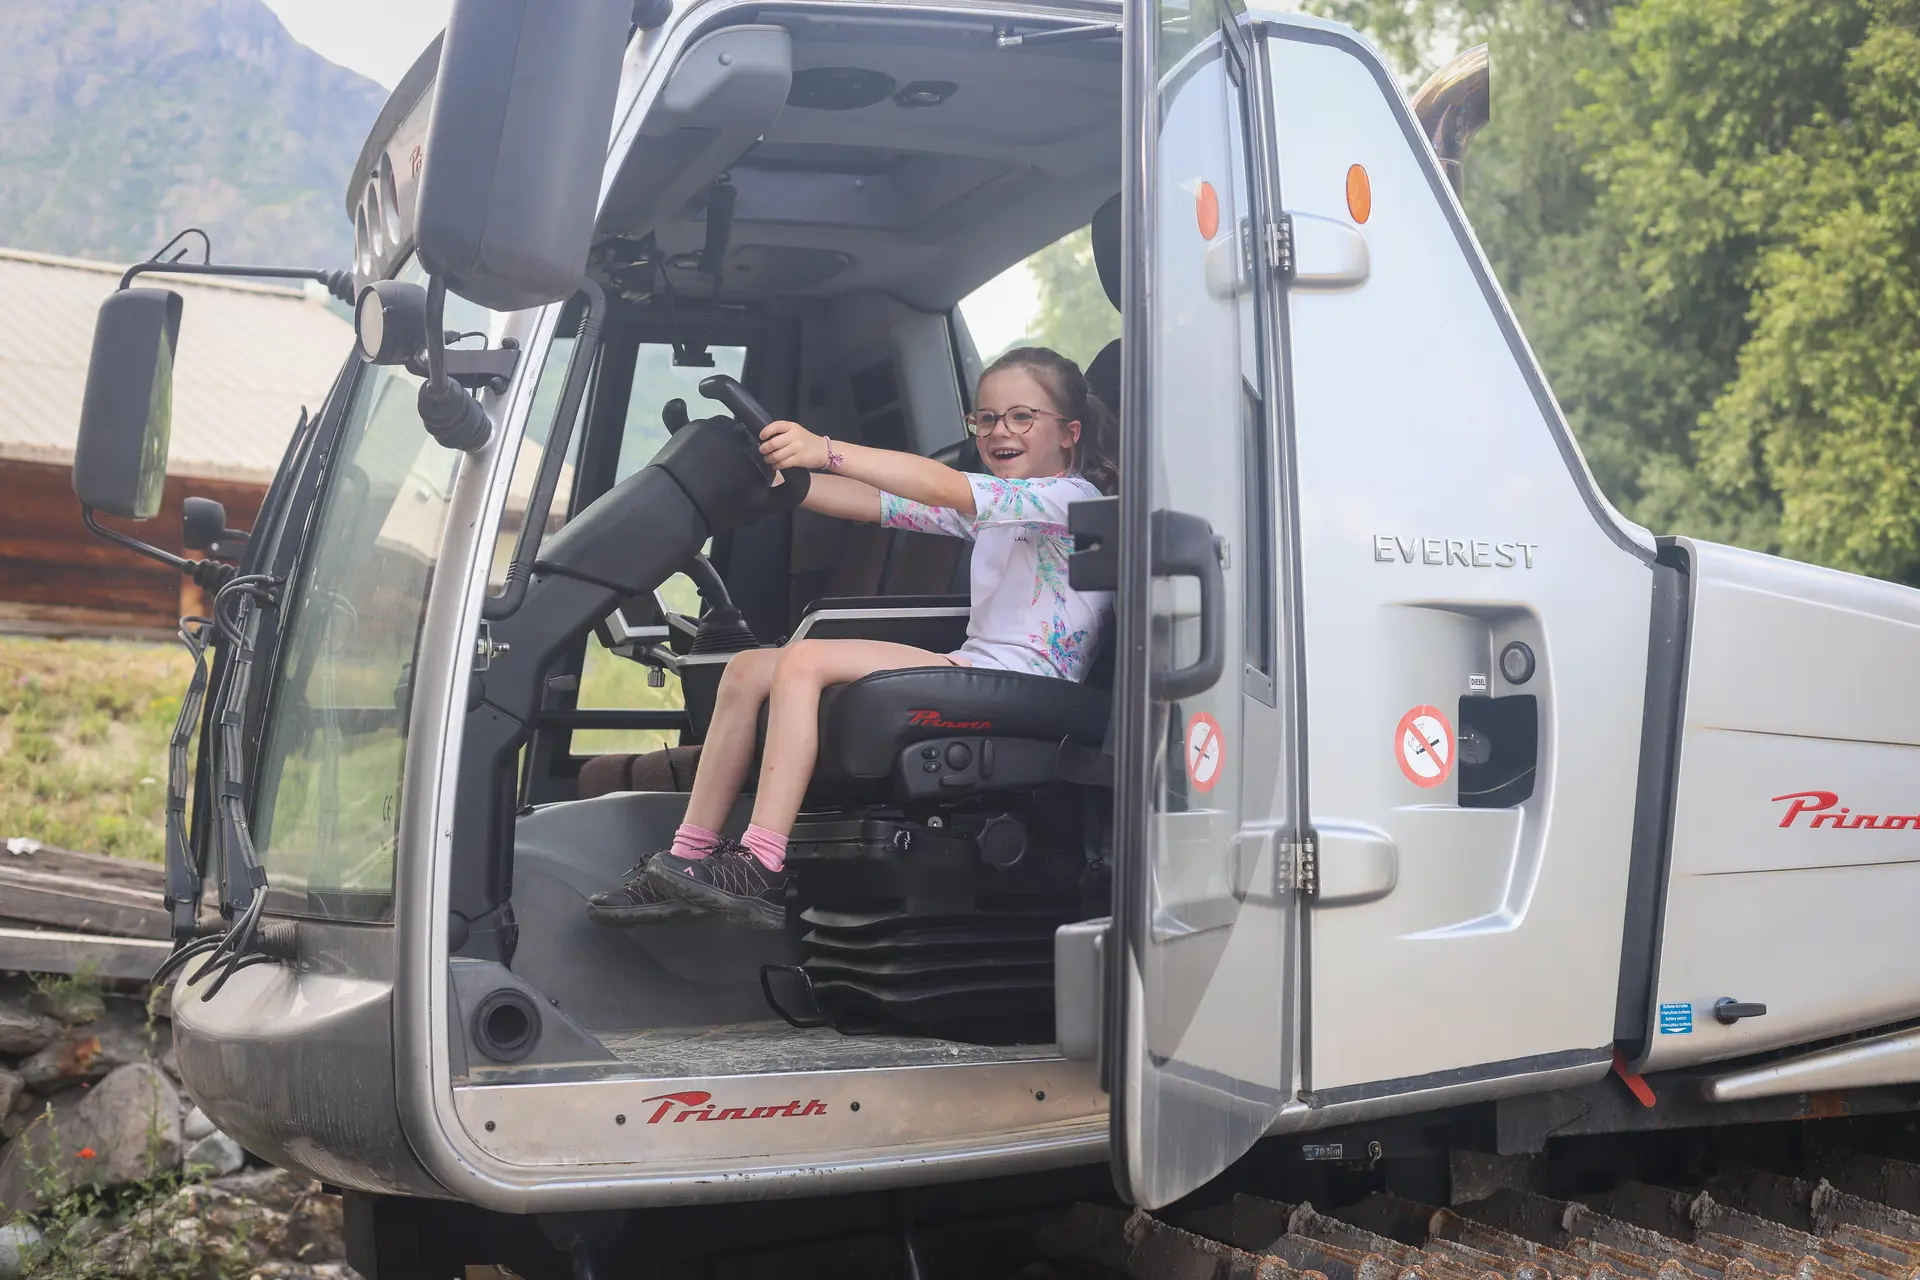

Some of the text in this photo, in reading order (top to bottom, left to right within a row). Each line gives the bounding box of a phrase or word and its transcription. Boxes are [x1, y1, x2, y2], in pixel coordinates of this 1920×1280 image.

[1373, 534, 1539, 569] EVEREST
[1471, 678, 1486, 686] DIESEL
[905, 709, 992, 729] Prinoth
[641, 1090, 828, 1125] Prinoth
[1314, 1147, 1325, 1156] 70
